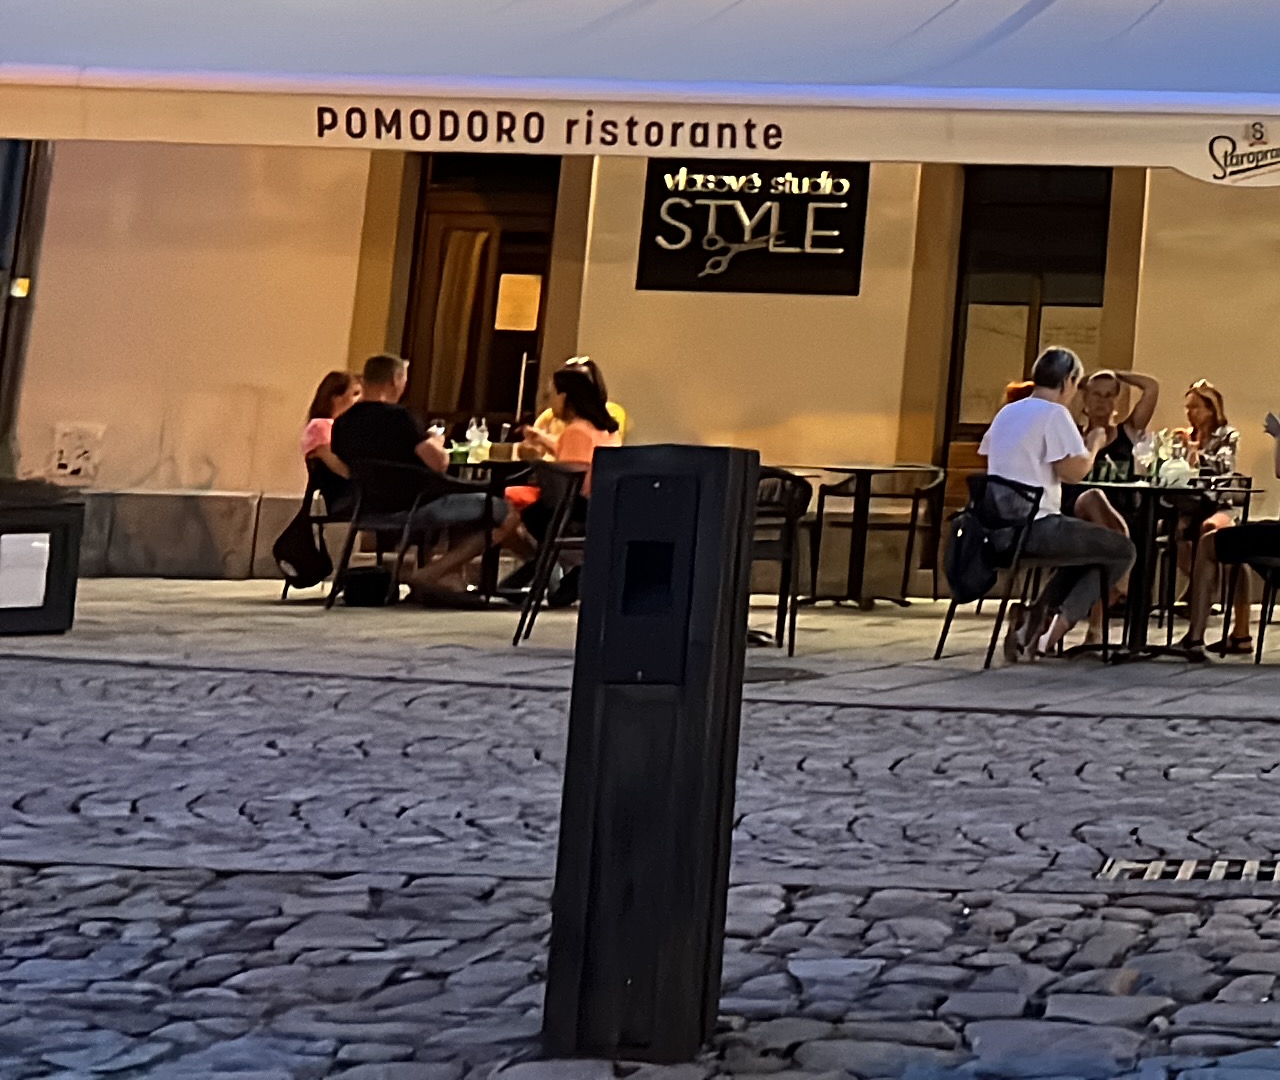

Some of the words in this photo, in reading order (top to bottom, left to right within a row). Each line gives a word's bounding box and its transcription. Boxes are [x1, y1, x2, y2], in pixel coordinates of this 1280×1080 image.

[316, 106, 546, 144] POMODORO
[566, 110, 784, 150] ristorante
[769, 170, 851, 196] studio
[655, 196, 848, 254] STYLE
